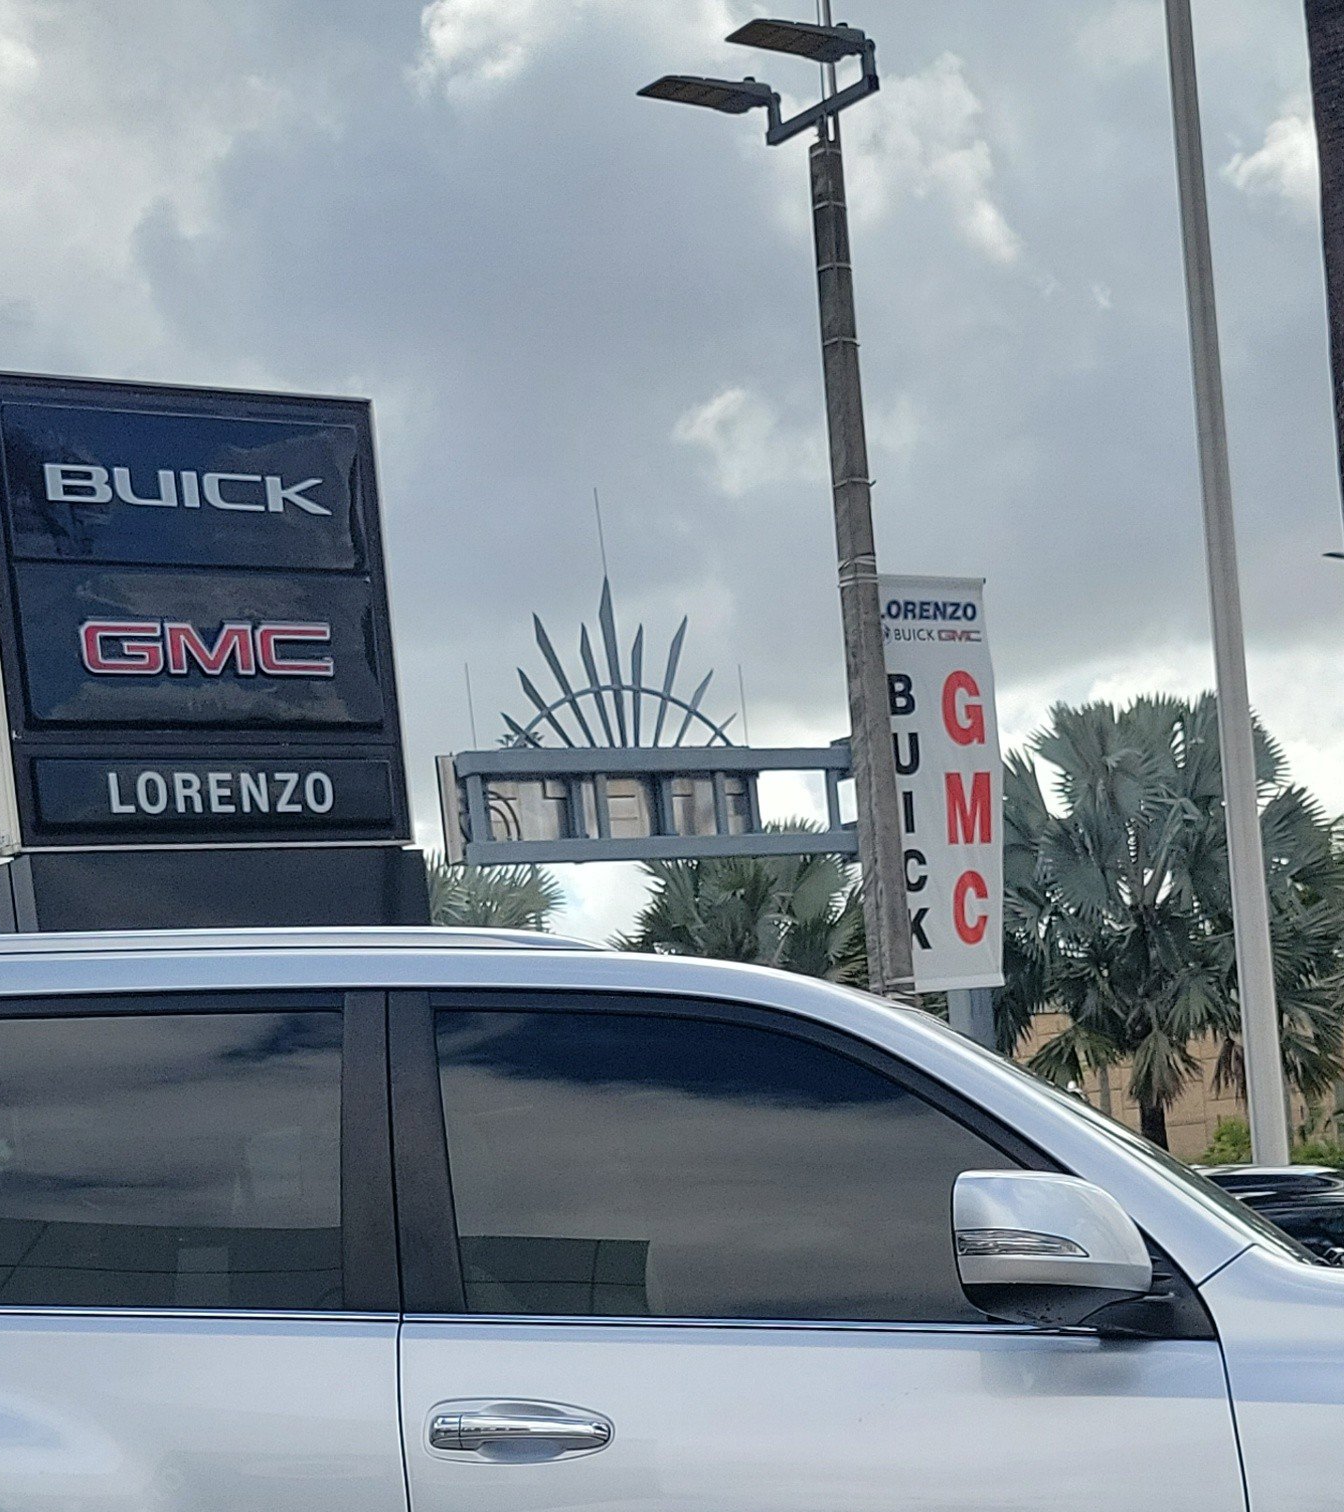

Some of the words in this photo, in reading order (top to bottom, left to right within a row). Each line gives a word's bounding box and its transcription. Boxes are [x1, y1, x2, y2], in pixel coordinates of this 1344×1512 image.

[43, 462, 332, 516] BUICK
[881, 600, 977, 621] ORENZO
[894, 628, 936, 641] BUICK
[937, 629, 982, 642] GMC
[80, 621, 334, 677] GMC
[107, 771, 334, 814] LORENZO
[887, 673, 933, 951] BUICK
[941, 670, 992, 946] GMC
